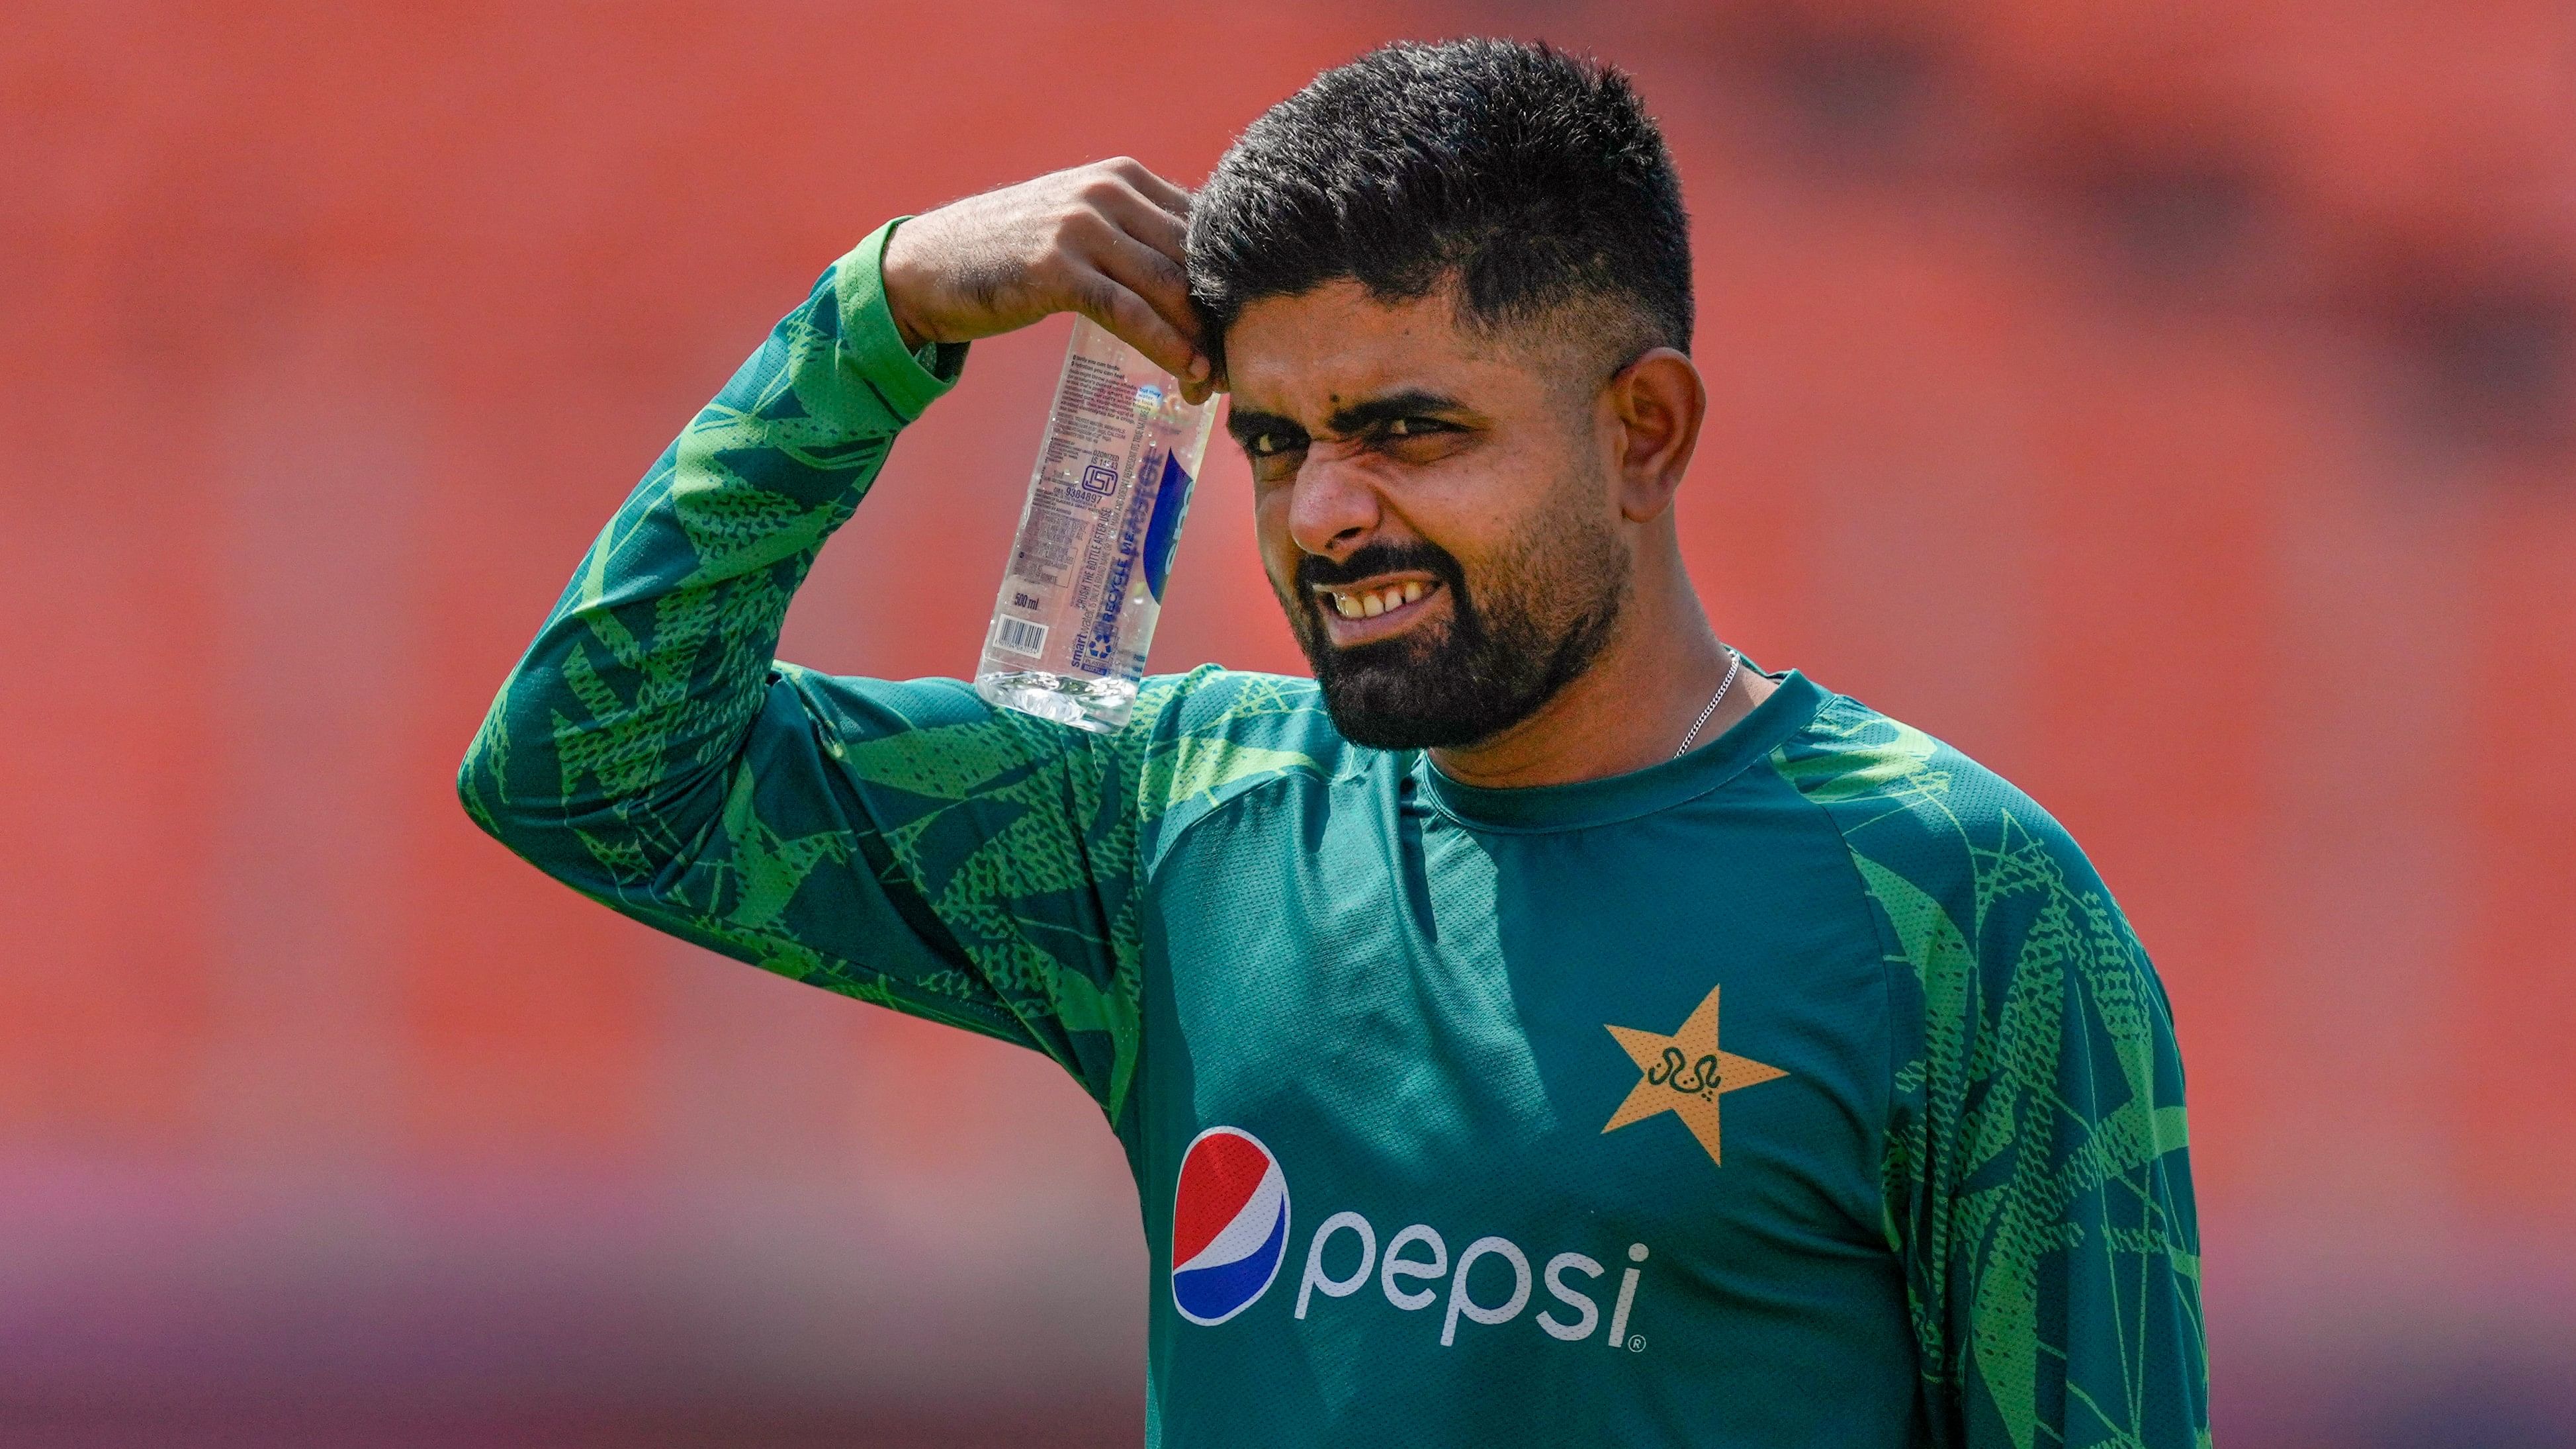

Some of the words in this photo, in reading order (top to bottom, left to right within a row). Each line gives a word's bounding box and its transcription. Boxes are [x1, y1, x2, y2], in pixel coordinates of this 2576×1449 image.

[1132, 428, 1143, 443] TRUE
[1090, 455, 1098, 464] IS
[1092, 449, 1120, 461] OZONIZED
[1065, 486, 1102, 504] 9384897
[1098, 505, 1112, 522] USE
[1092, 521, 1108, 545] AFTER
[1085, 545, 1102, 570] BOTTLE
[1081, 570, 1094, 584] THE
[1075, 584, 1091, 609] CRUSH
[1101, 557, 1128, 623] RECYCLE
[1014, 593, 1028, 607] 500
[1028, 598, 1039, 610] ml
[1294, 1211, 1649, 1347] pepsi
